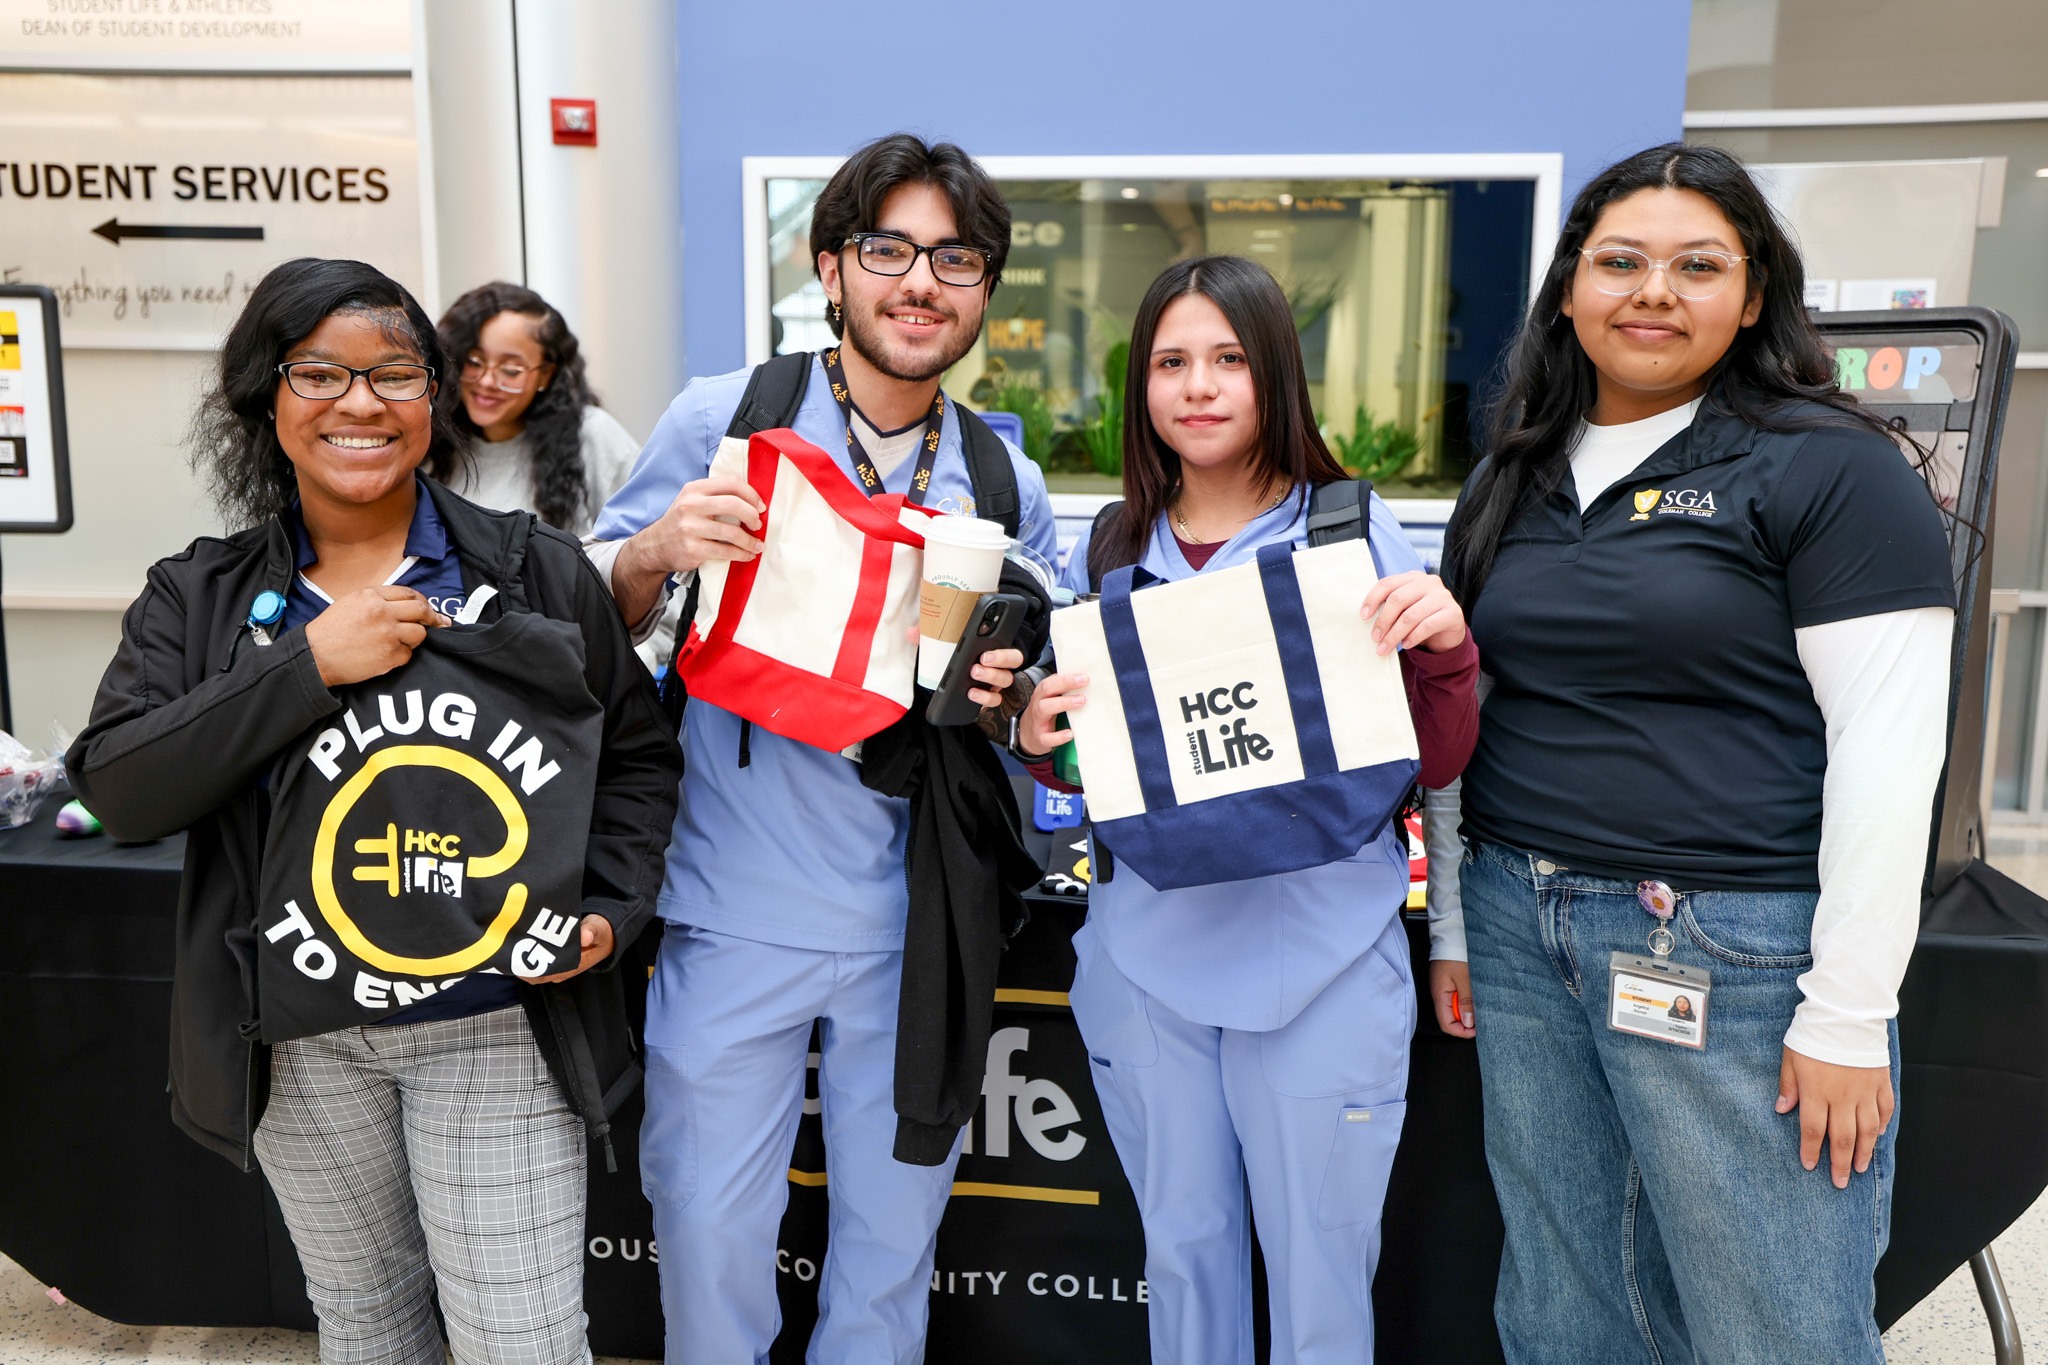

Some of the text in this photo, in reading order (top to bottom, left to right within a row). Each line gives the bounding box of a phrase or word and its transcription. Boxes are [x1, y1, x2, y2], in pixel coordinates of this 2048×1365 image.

[21, 20, 303, 38] DEAN OF STUDENT DEVELOPMENT
[0, 163, 390, 202] UDENT SERVICES
[136, 283, 171, 319] you
[181, 270, 234, 304] need
[1833, 346, 1942, 390] ROP
[856, 463, 877, 487] HCC
[914, 468, 931, 492] HCC
[1660, 489, 1718, 511] SGA
[427, 596, 464, 618] SG
[1179, 681, 1258, 724] HCC
[307, 689, 562, 796] PLUG IN
[1186, 717, 1274, 776] student Life
[404, 829, 461, 858] HCC
[264, 900, 579, 1009] TO ENGE
[1027, 1271, 1149, 1304] COLLE
